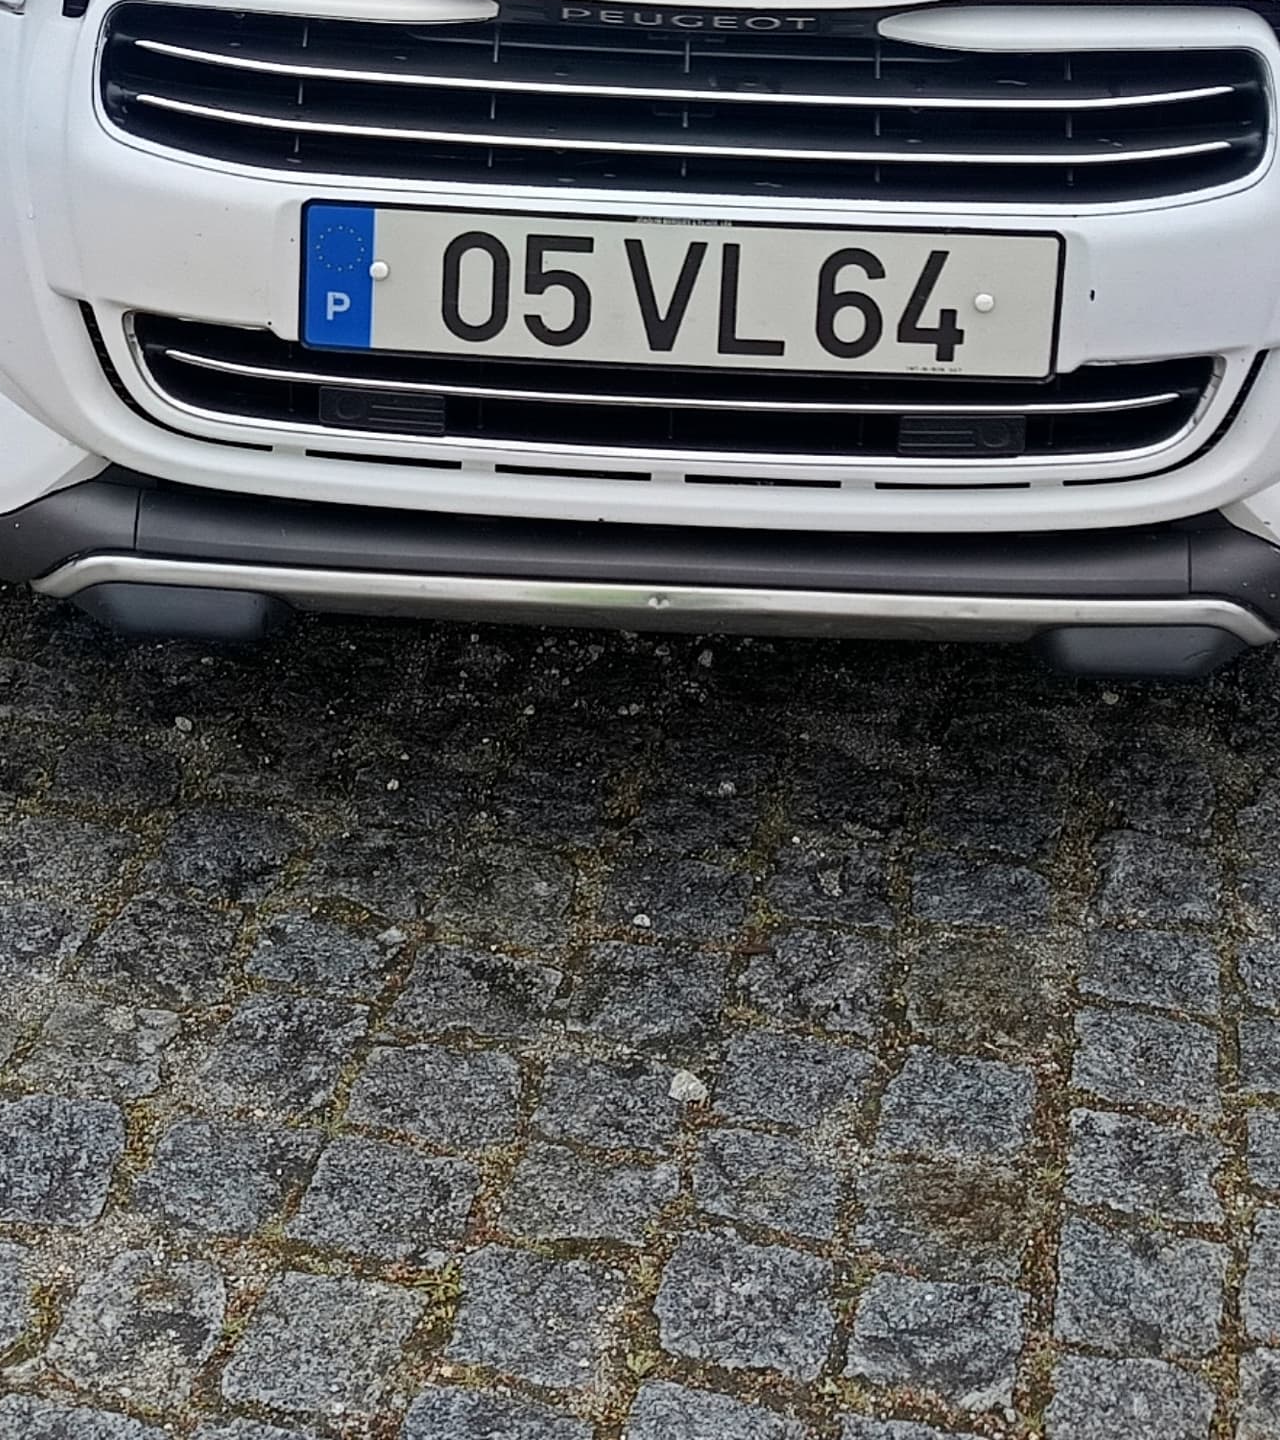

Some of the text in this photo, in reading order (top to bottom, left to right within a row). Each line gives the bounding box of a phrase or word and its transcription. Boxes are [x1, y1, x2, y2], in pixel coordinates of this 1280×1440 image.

[561, 7, 816, 30] PEUGEOT
[326, 291, 351, 320] P
[441, 230, 965, 362] 05 VL 64
